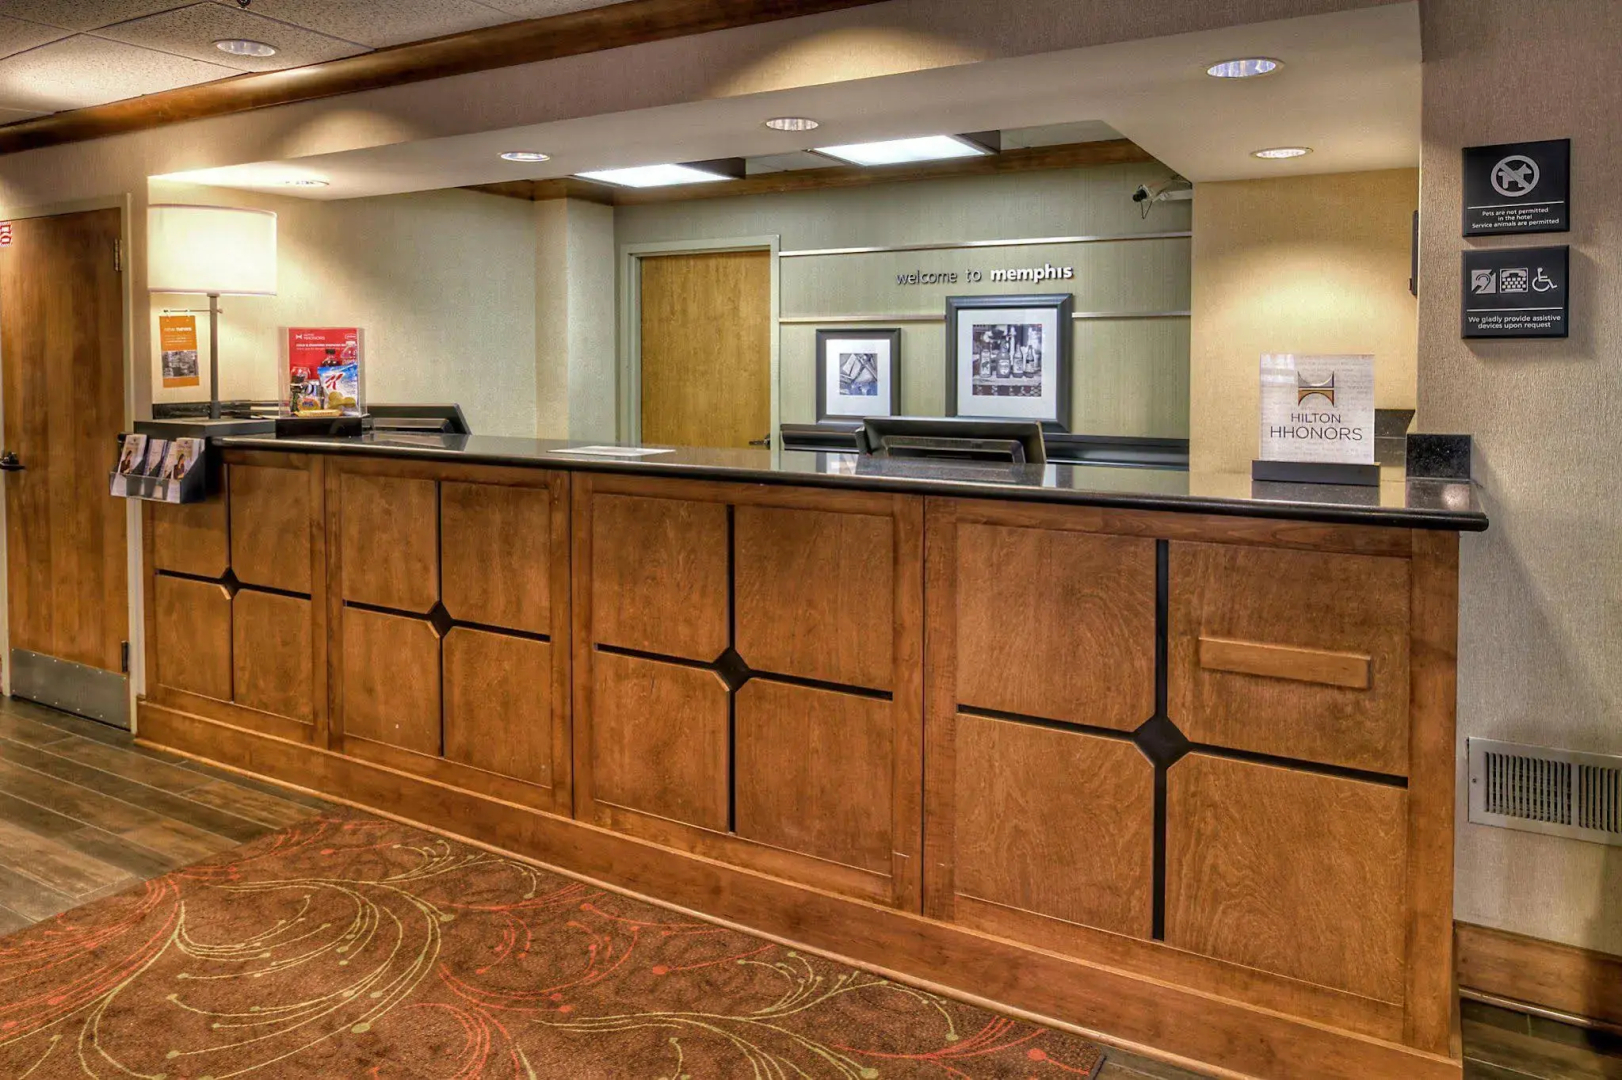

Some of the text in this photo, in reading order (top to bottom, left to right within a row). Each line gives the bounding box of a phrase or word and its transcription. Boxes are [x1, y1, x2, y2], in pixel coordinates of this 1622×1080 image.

[1518, 207, 1549, 215] permitted
[1528, 218, 1559, 226] permitted
[896, 263, 1074, 286] welcome to memphis
[1481, 315, 1503, 324] gladly
[1504, 315, 1531, 323] provide
[1532, 314, 1561, 322] assistive
[1291, 412, 1342, 424] HILTON
[1270, 426, 1363, 441] HHONORS
